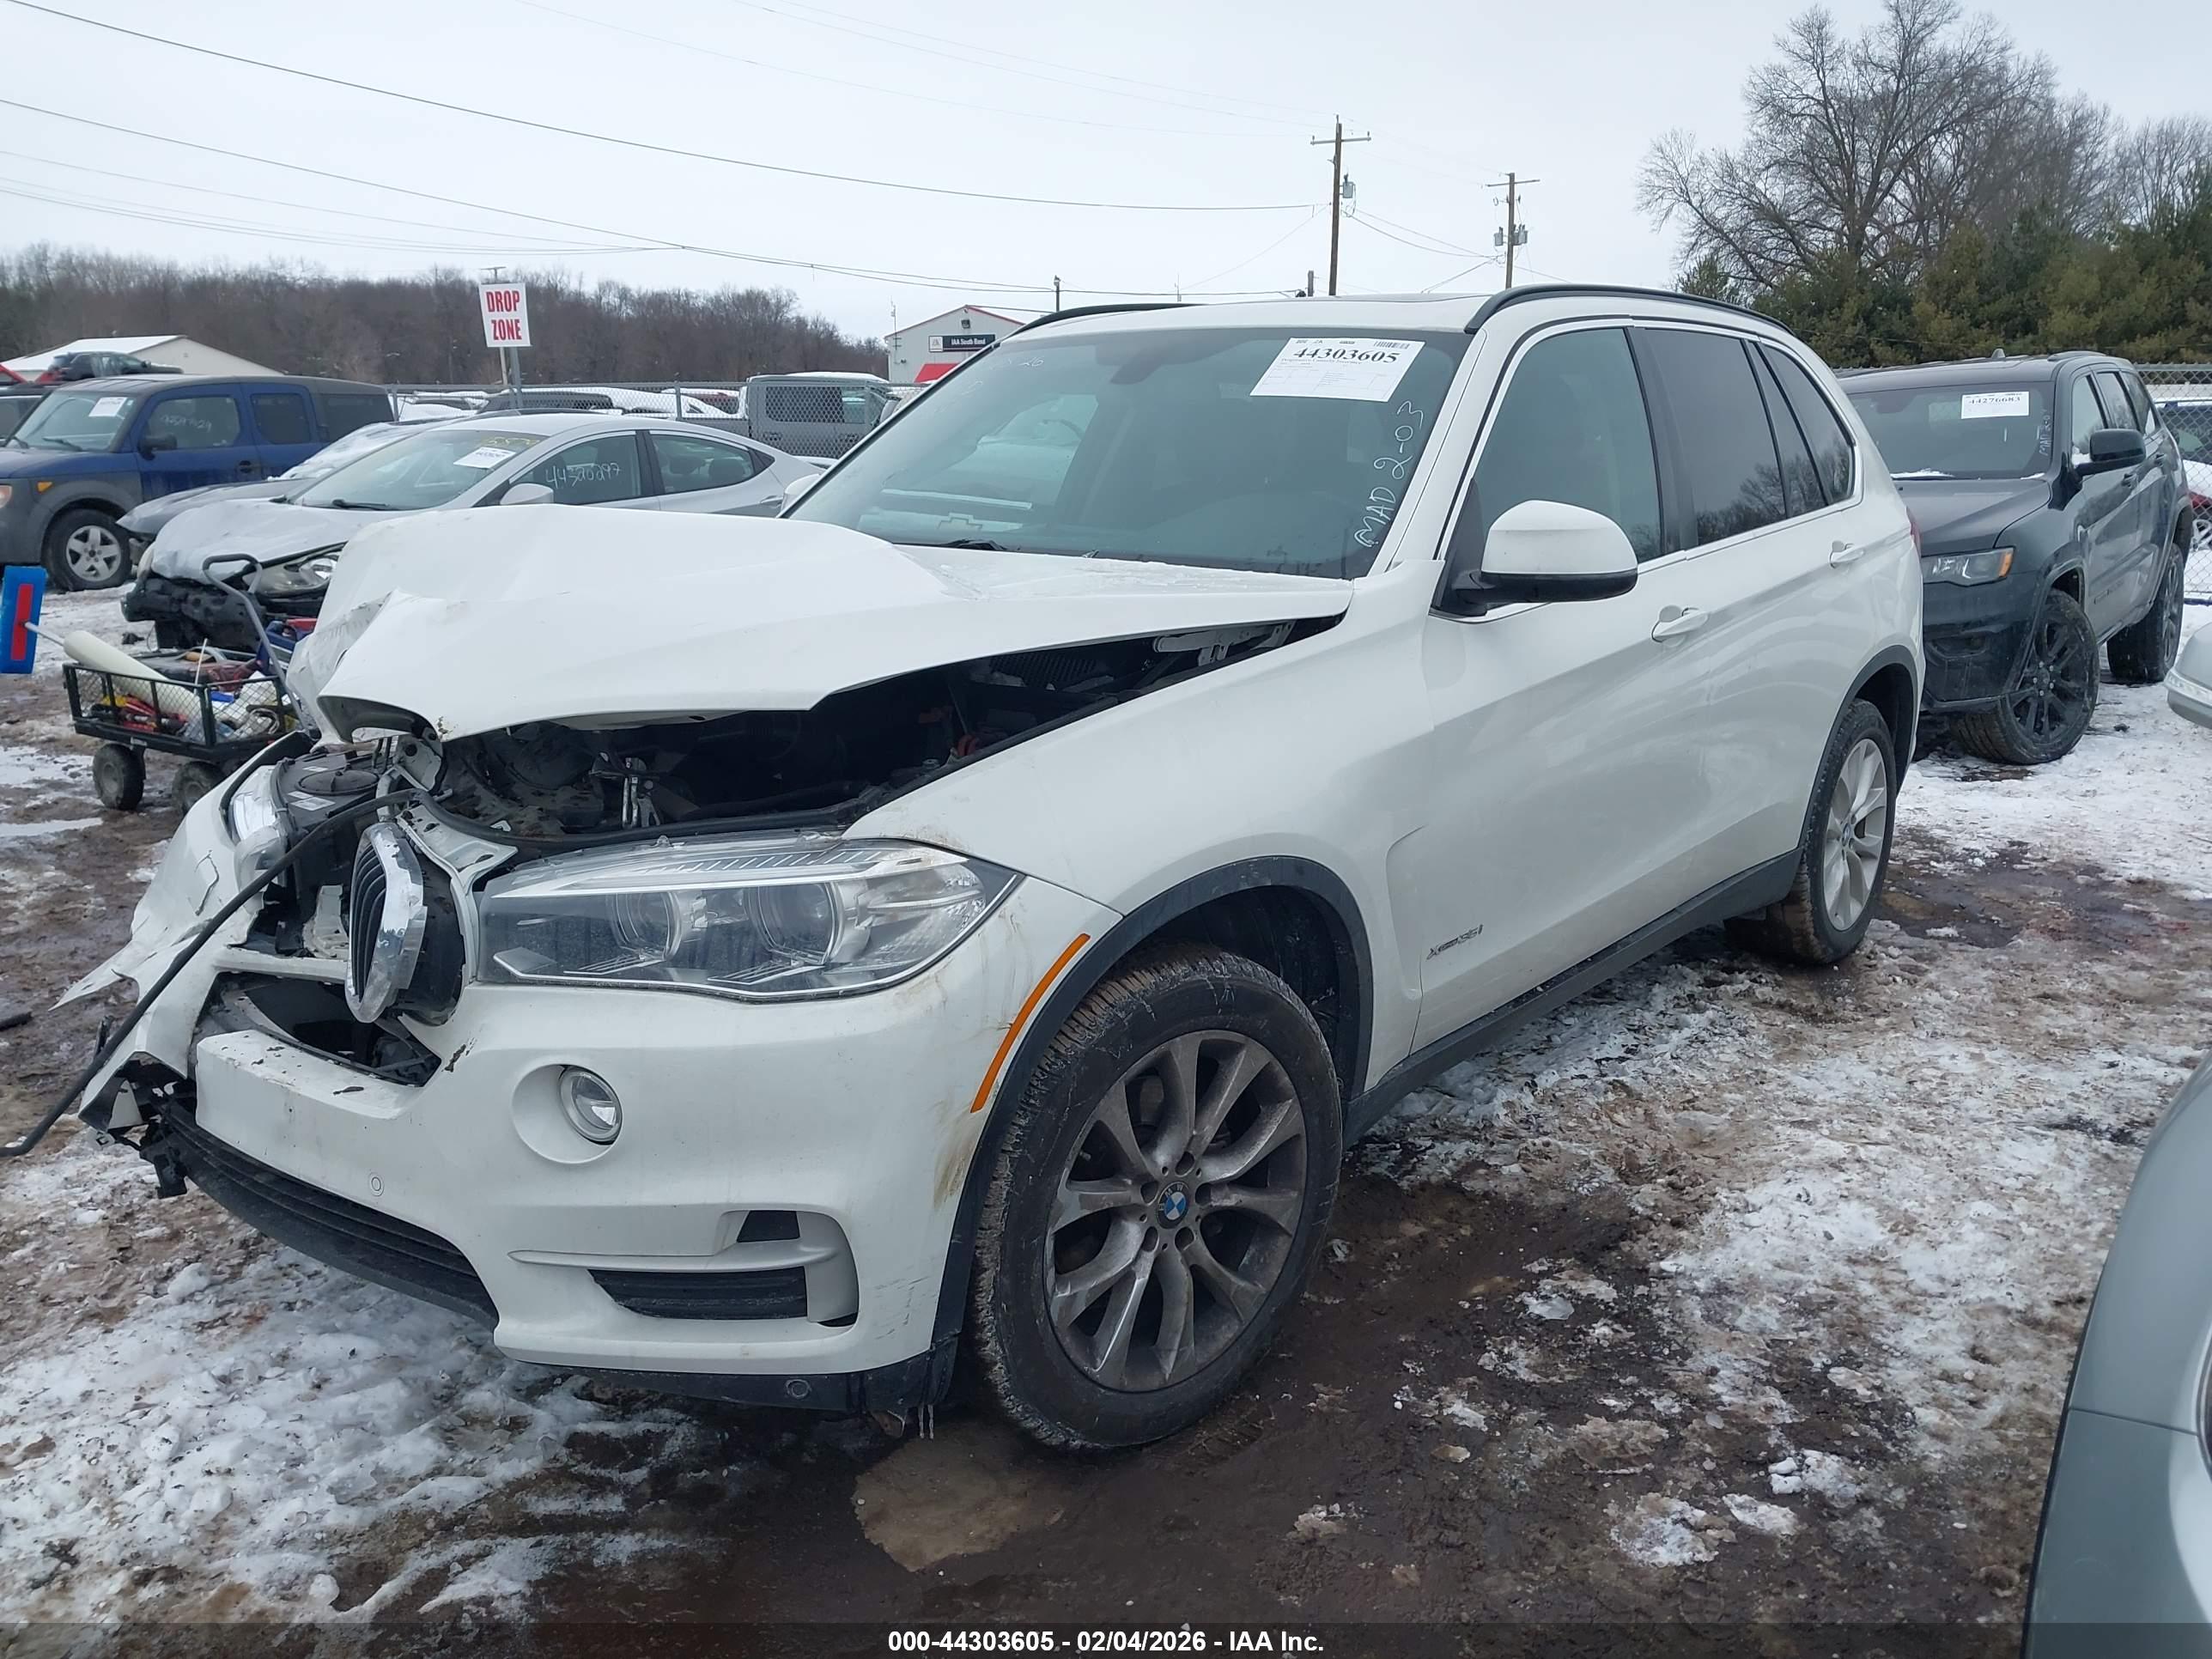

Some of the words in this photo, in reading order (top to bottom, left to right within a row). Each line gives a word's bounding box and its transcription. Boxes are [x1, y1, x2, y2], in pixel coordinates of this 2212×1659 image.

[486, 290, 520, 313] DROP
[490, 319, 523, 340] ZONE
[1292, 347, 1401, 364] 44303605
[1968, 396, 2021, 405] 44276683
[1373, 400, 1425, 480] 2-03
[1353, 486, 1397, 548] MAD
